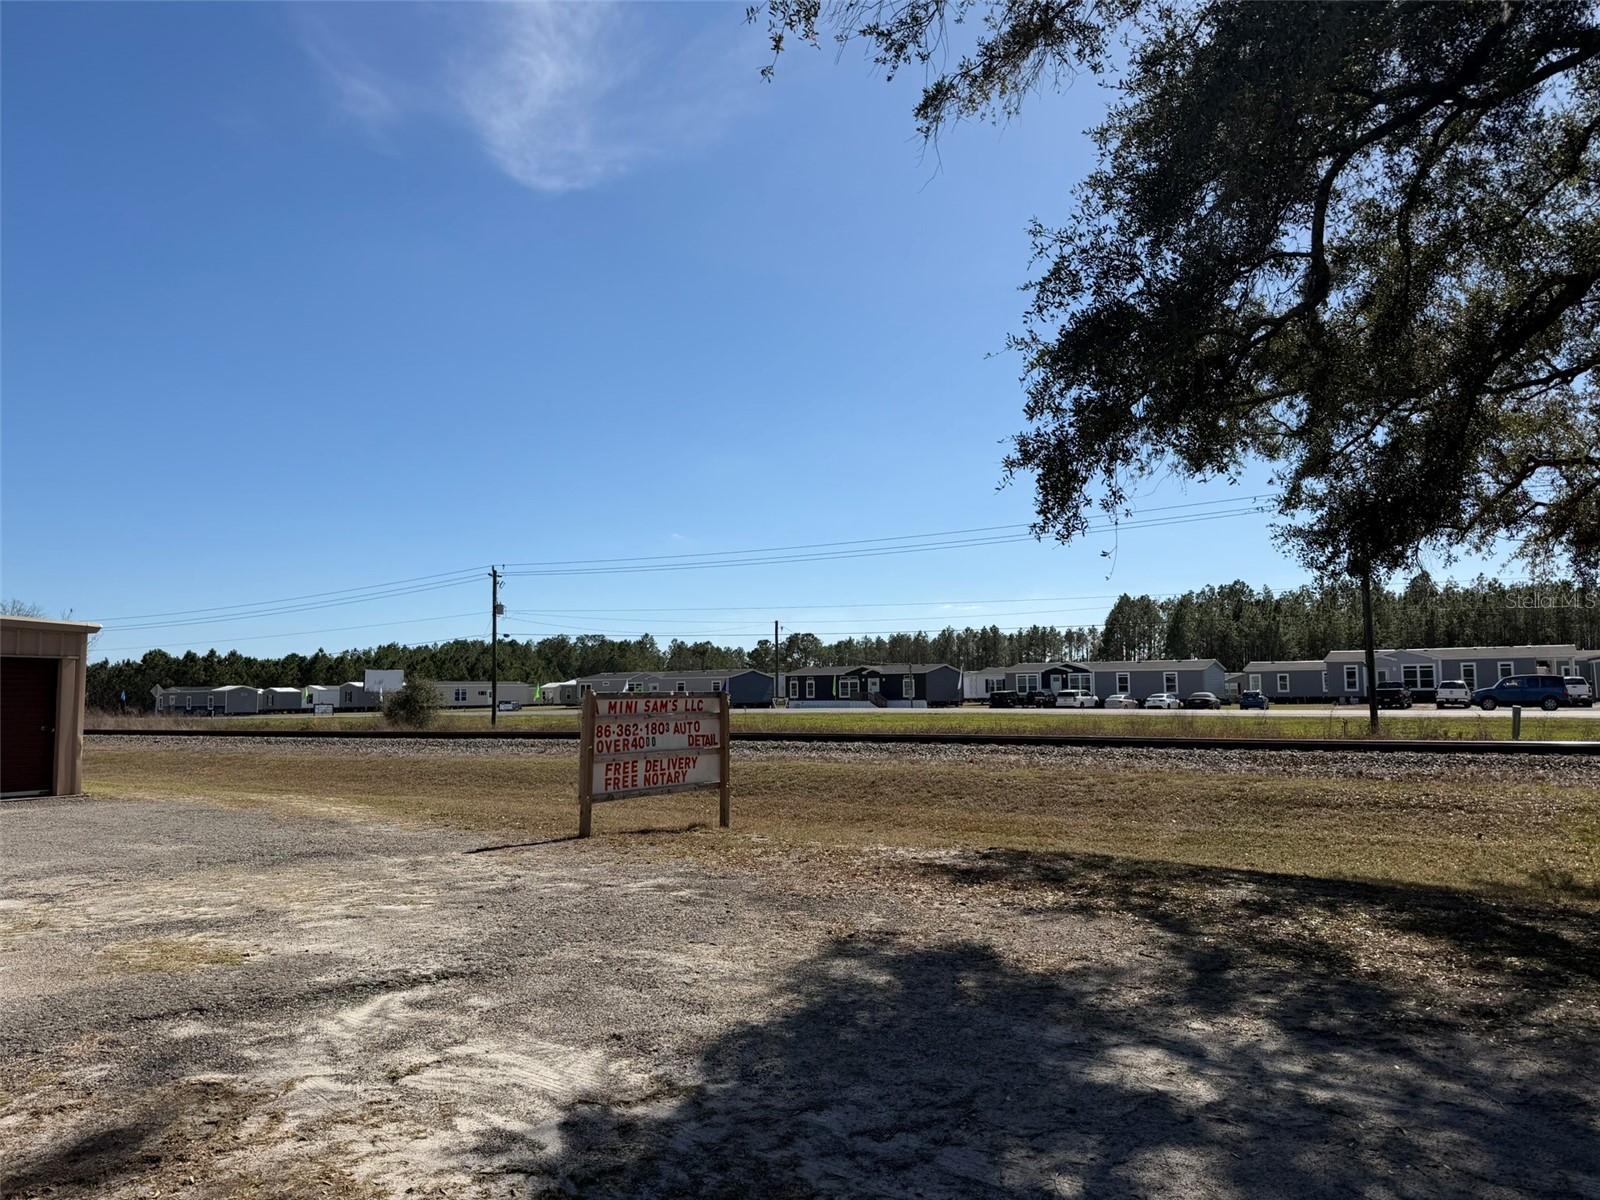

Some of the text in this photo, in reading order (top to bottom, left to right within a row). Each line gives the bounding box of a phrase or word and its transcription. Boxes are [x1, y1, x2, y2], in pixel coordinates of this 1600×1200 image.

[608, 701, 638, 714] MINI
[644, 700, 678, 712] SAM'S
[684, 699, 704, 712] LLC
[673, 720, 700, 735] AUTO
[687, 734, 719, 747] DETAIL
[604, 756, 698, 776] FREE DELIVERY
[604, 770, 688, 791] FREE NOTARY
